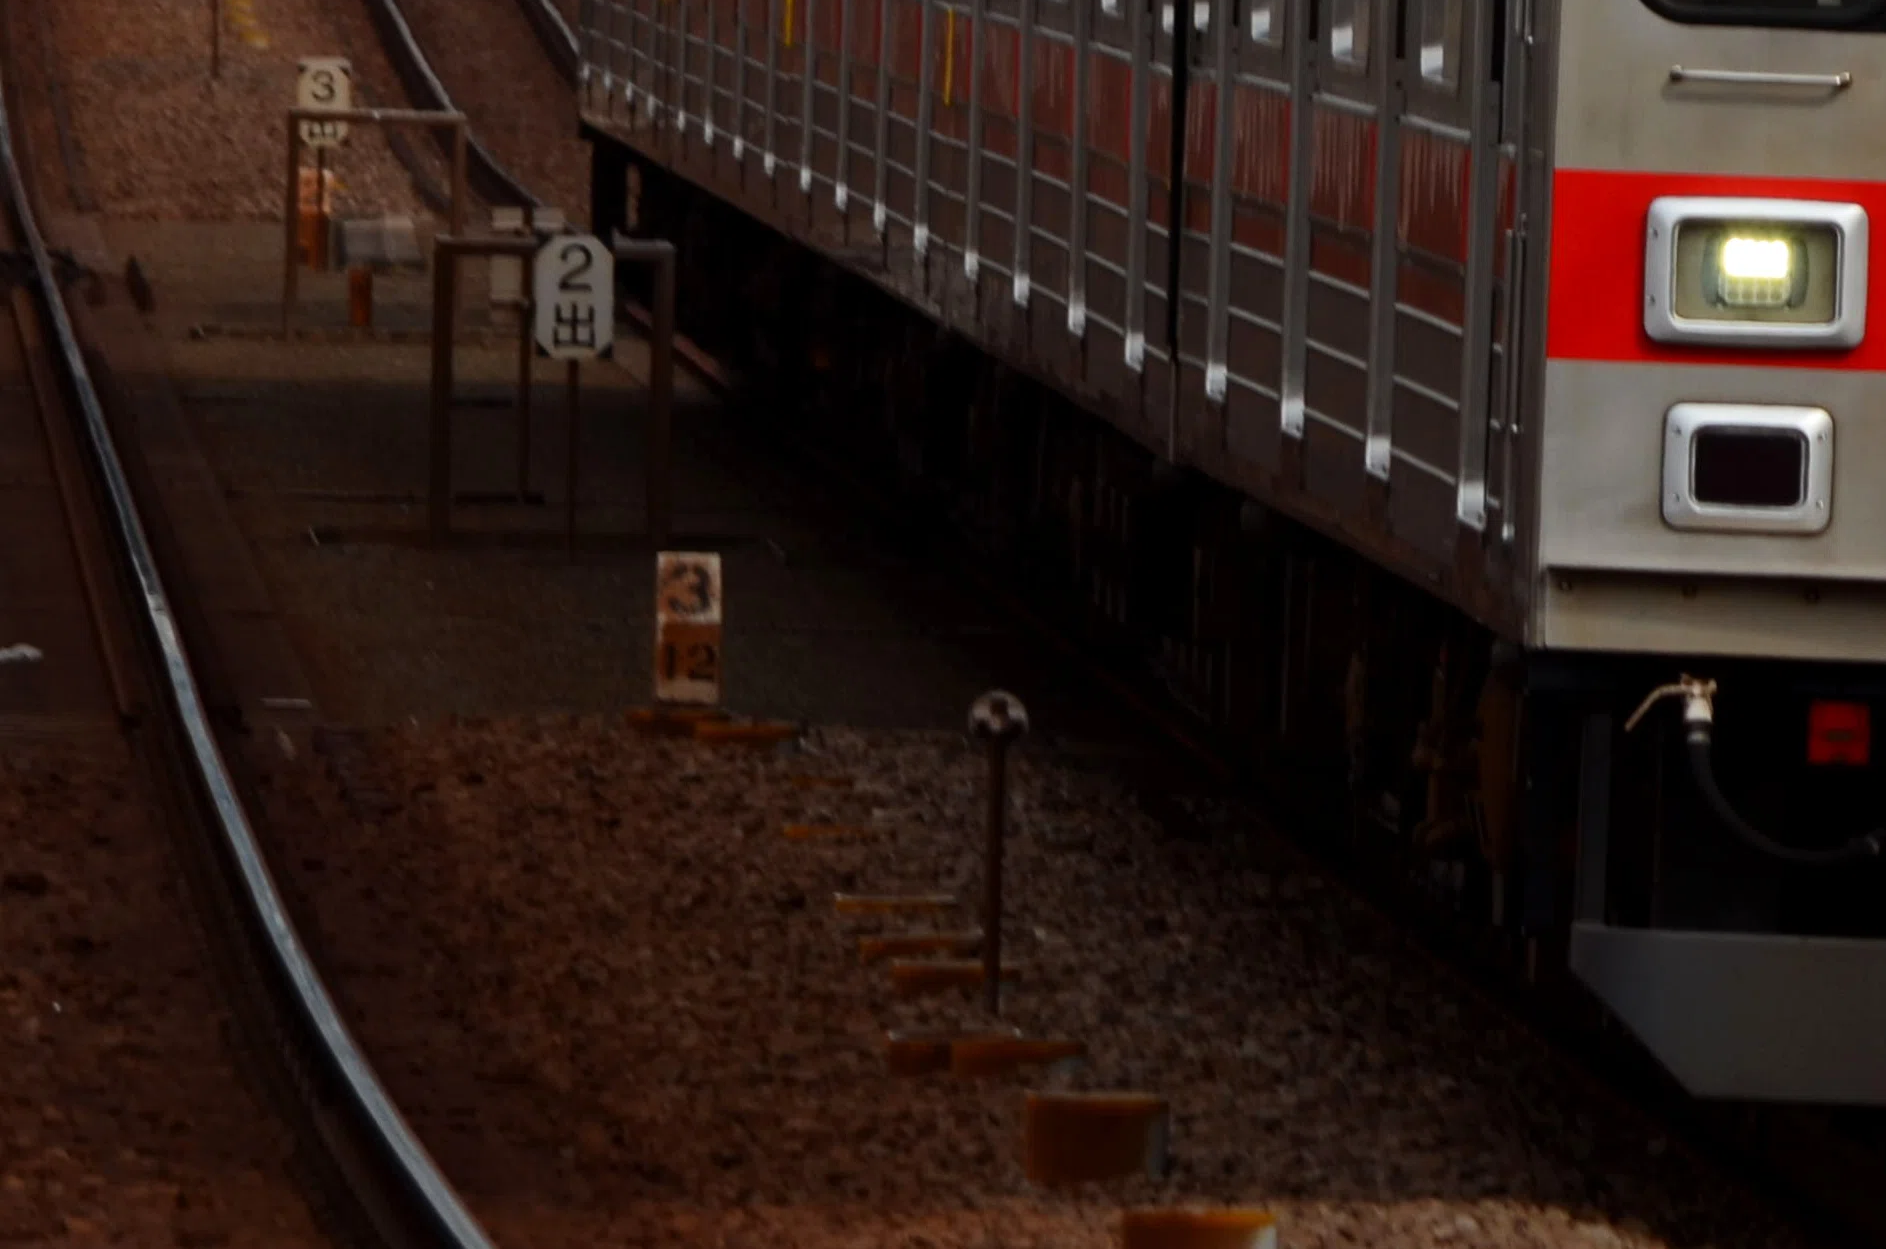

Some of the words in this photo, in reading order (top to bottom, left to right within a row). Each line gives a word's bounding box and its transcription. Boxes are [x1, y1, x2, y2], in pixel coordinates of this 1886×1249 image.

[310, 69, 337, 100] 3
[558, 243, 594, 292] 2
[668, 562, 711, 615] 3
